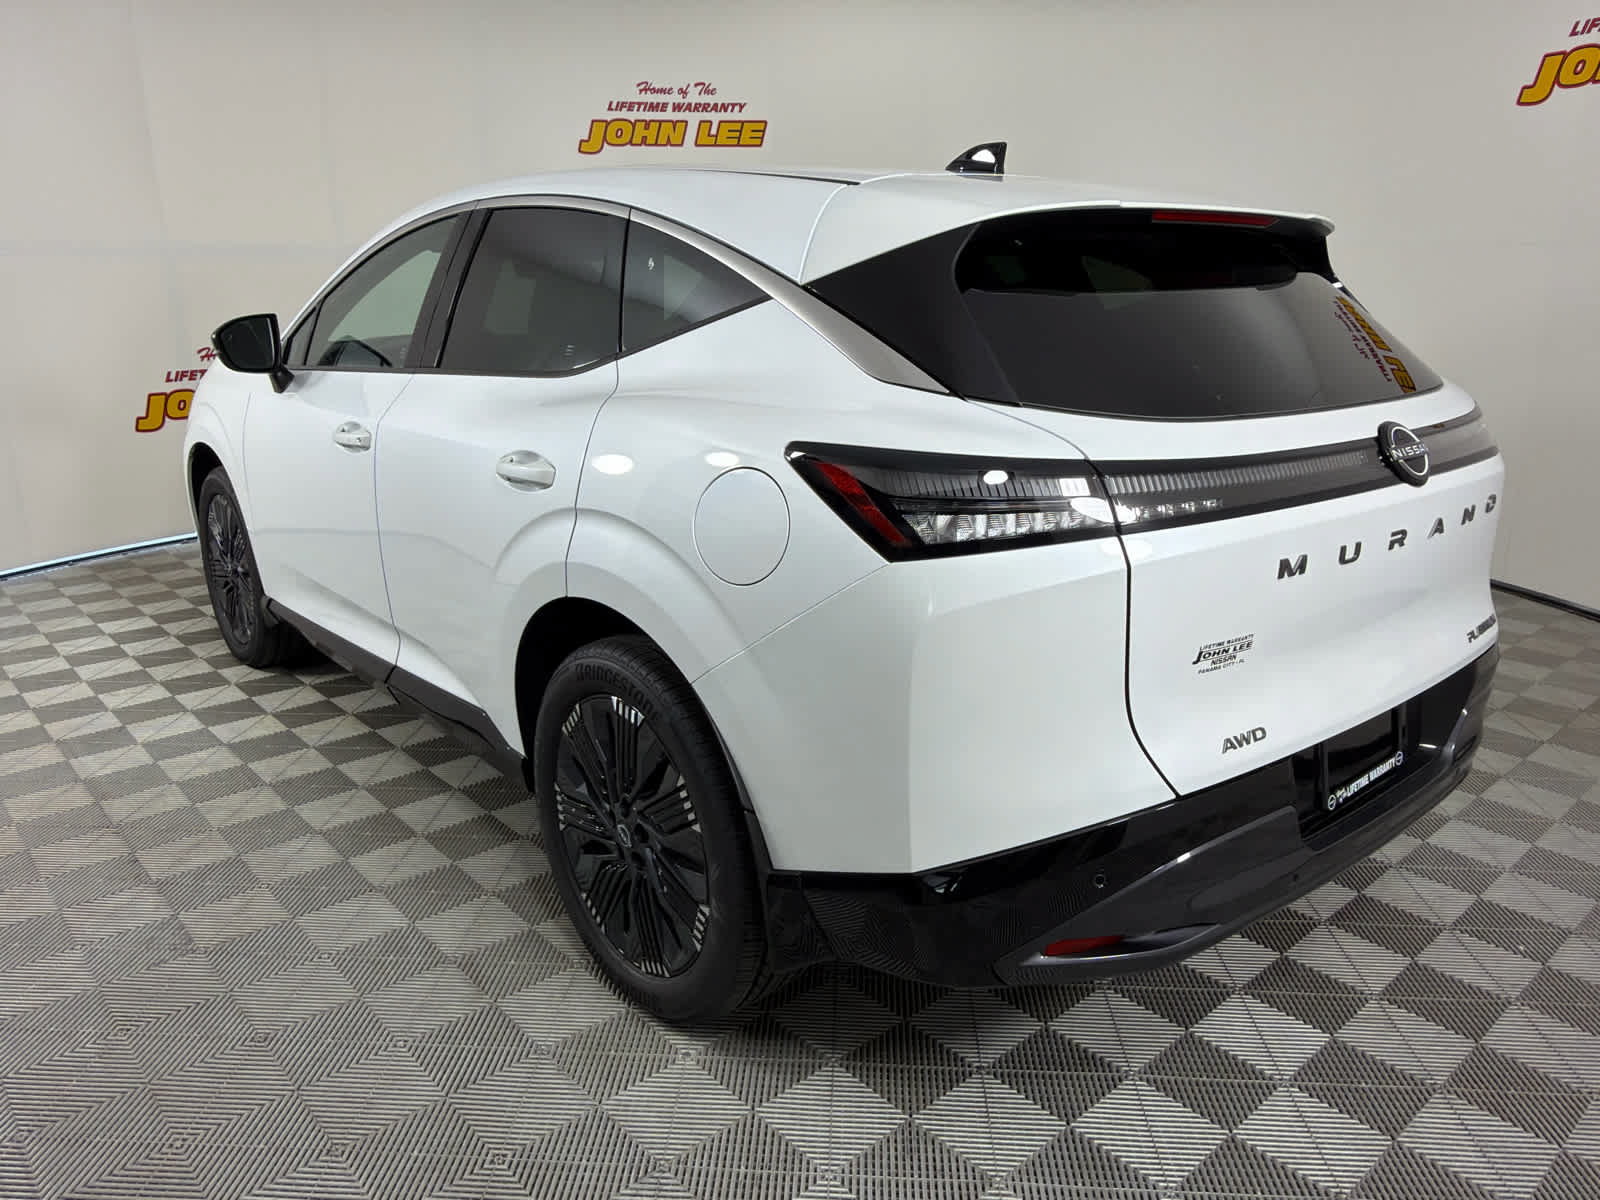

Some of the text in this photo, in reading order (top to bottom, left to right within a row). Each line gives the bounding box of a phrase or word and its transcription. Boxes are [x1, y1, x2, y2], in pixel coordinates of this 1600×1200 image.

[1569, 17, 1600, 37] LIF
[1516, 43, 1600, 106] JO
[636, 81, 717, 99] Home of The
[607, 101, 747, 113] LIFETIME WARRANTY
[578, 118, 768, 154] JOHN LEE
[1391, 443, 1428, 460] NISSA
[1277, 494, 1497, 580] MURANO
[1192, 641, 1253, 665] JOHN LEE
[1222, 726, 1267, 754] AWD
